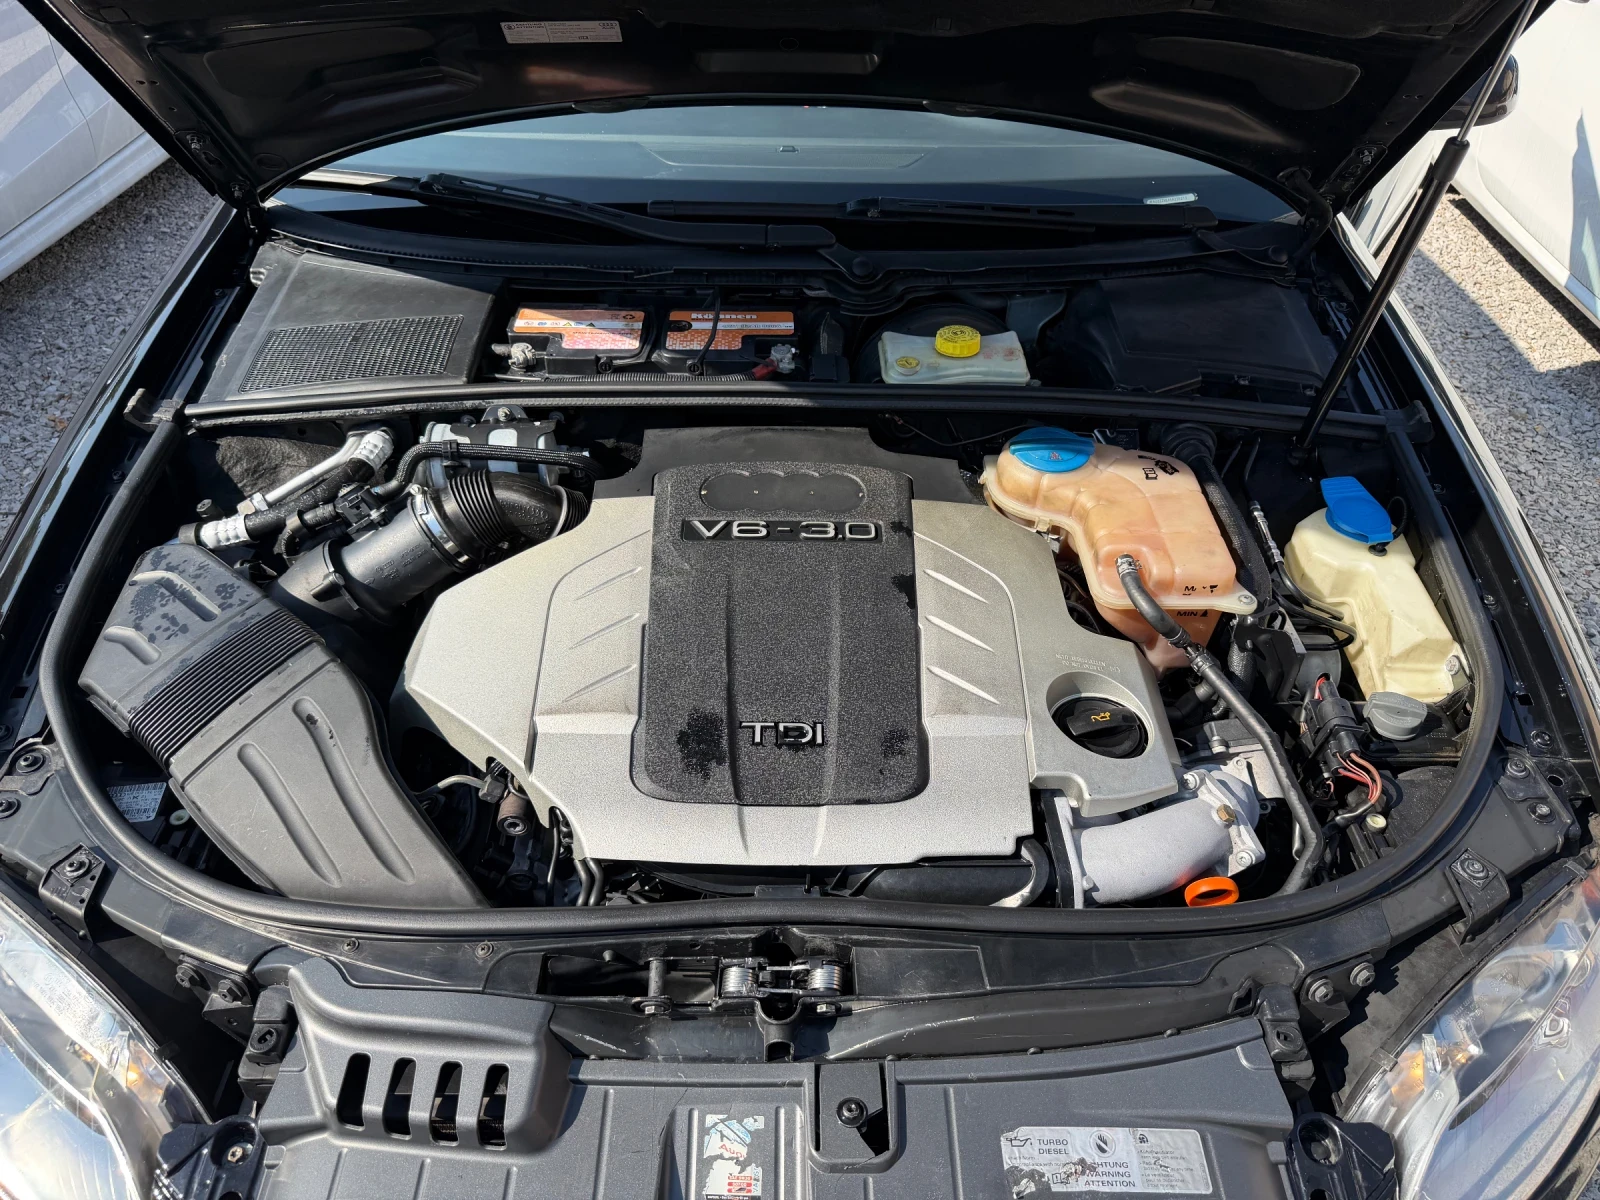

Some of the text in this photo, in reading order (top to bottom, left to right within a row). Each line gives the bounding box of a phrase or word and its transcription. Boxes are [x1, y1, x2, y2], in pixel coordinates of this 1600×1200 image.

[740, 722, 824, 745] TDI
[1037, 1138, 1069, 1146] TURBO
[1086, 1170, 1131, 1178] WARNING
